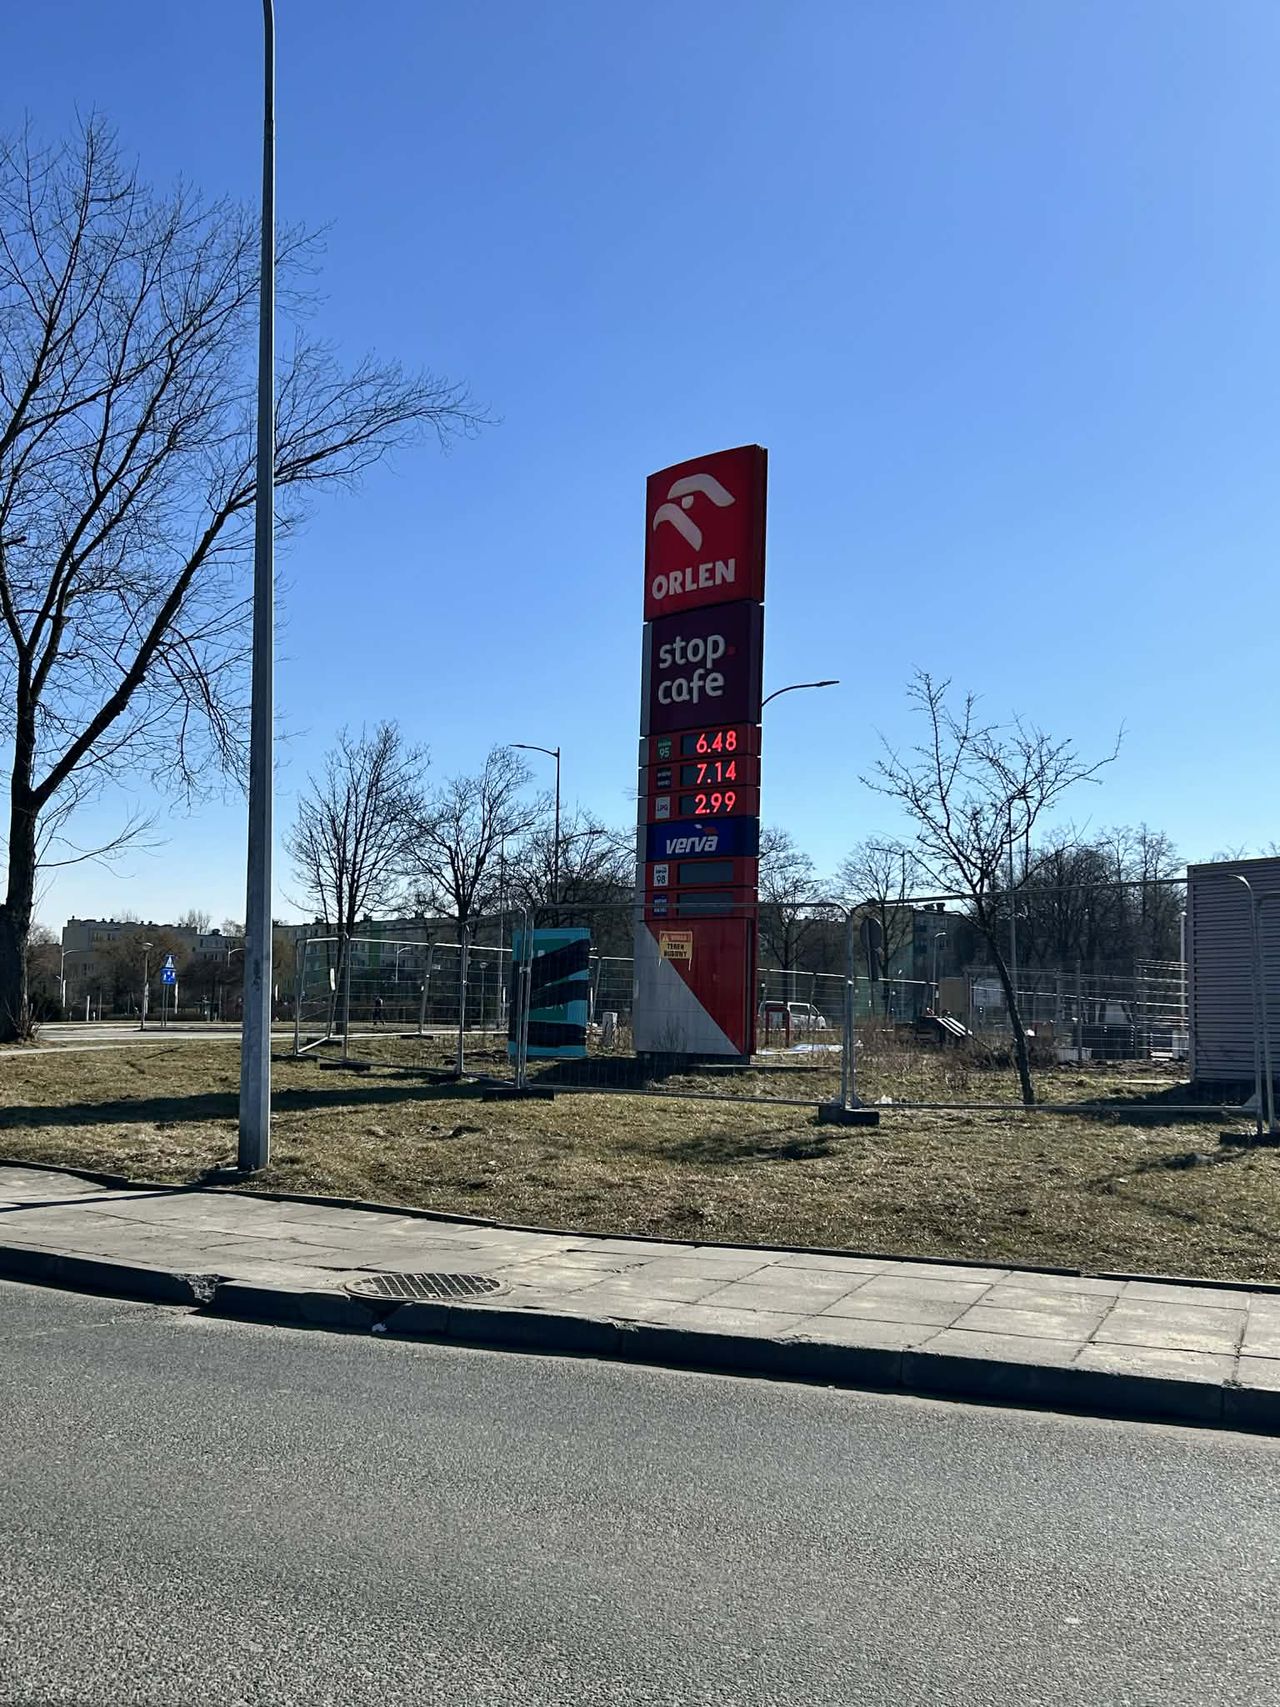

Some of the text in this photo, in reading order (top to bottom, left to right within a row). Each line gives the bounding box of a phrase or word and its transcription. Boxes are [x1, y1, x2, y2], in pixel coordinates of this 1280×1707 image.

[651, 558, 736, 600] ORLEN
[658, 669, 724, 705] cafe
[659, 730, 737, 759] 95 6.48
[696, 760, 737, 784] 7.14
[695, 791, 736, 815] 2.99
[666, 835, 719, 855] verva
[656, 875, 666, 884] 98
